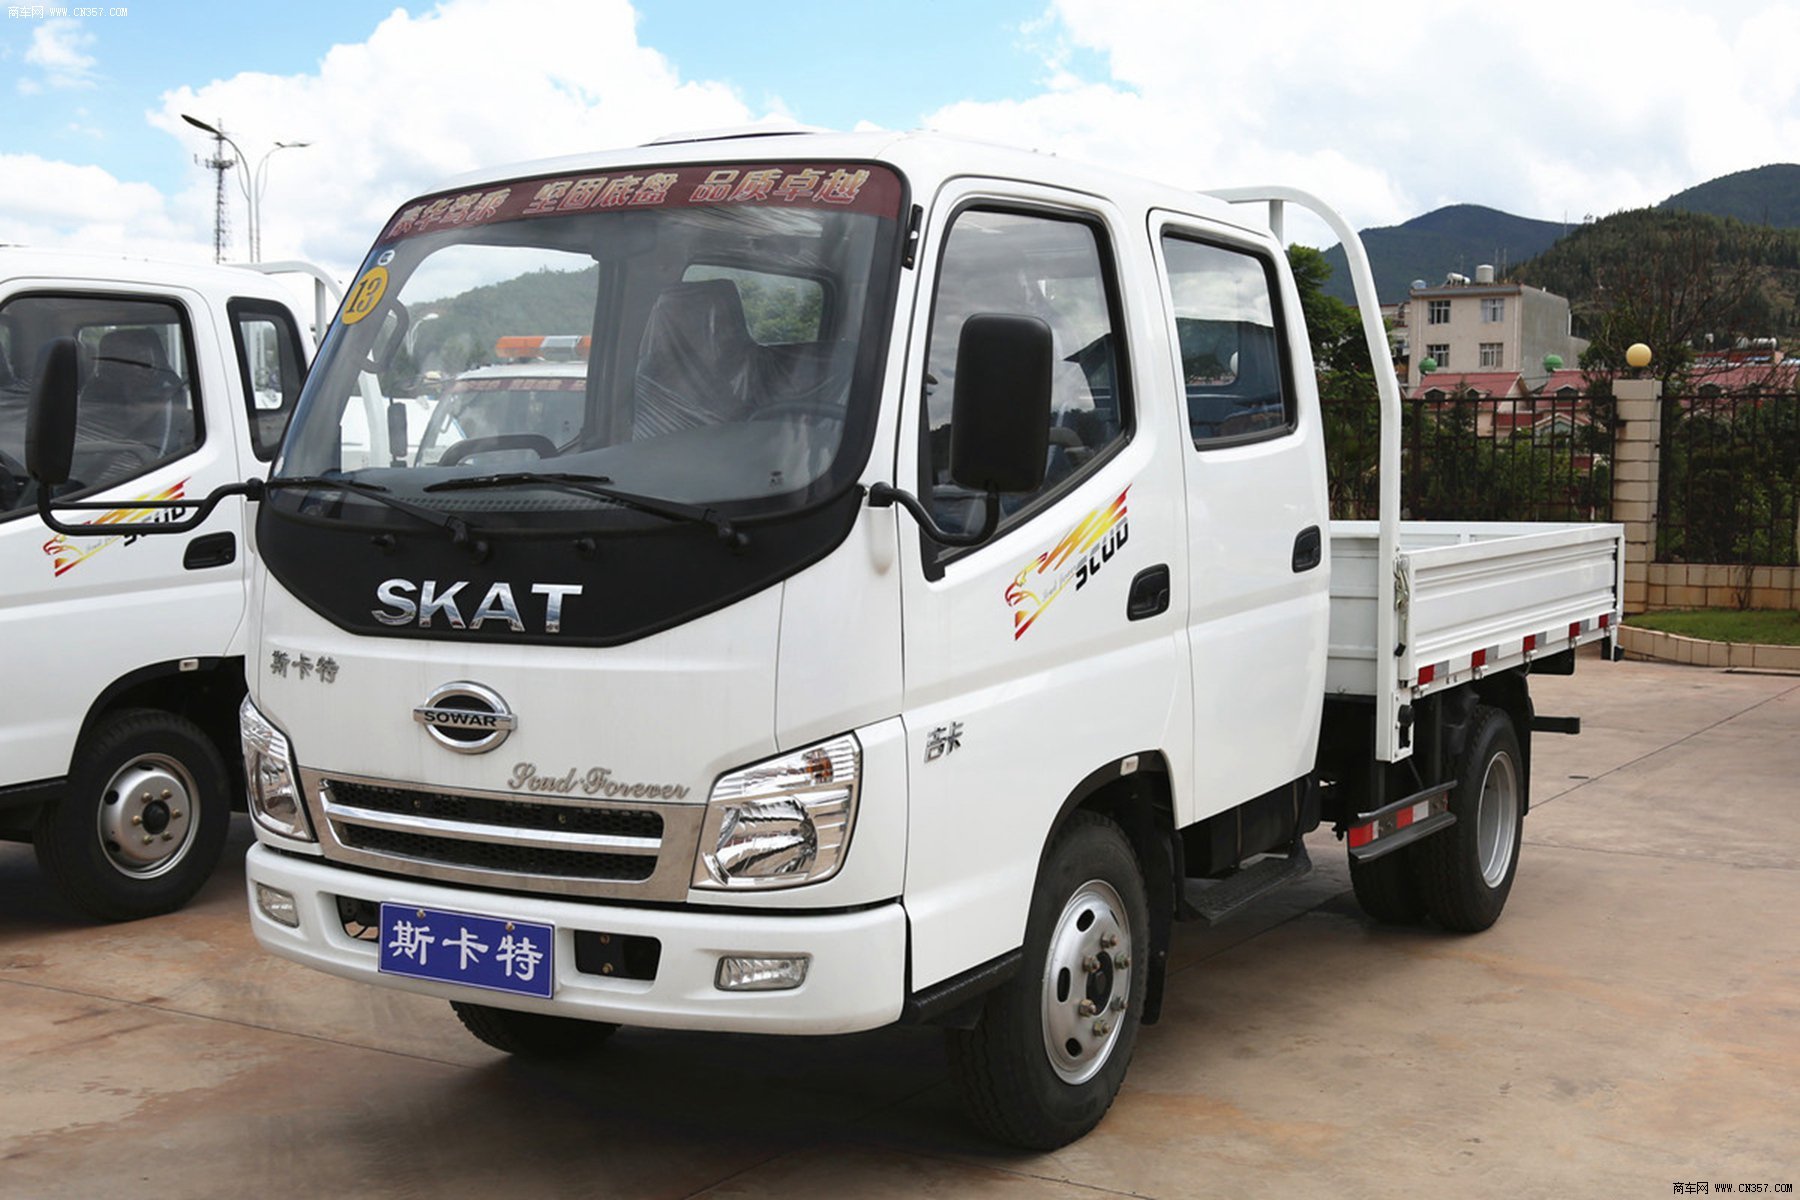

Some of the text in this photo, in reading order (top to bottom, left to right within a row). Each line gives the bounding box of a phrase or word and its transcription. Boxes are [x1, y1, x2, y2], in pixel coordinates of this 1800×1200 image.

[523, 172, 678, 214] 坚固底盘
[689, 168, 870, 204] 品质卓越
[346, 276, 382, 313] 13
[371, 578, 583, 633] SKAT
[270, 650, 340, 684] 斯卡特
[424, 710, 497, 727] SOWAR
[388, 920, 544, 981] 斯卡特
